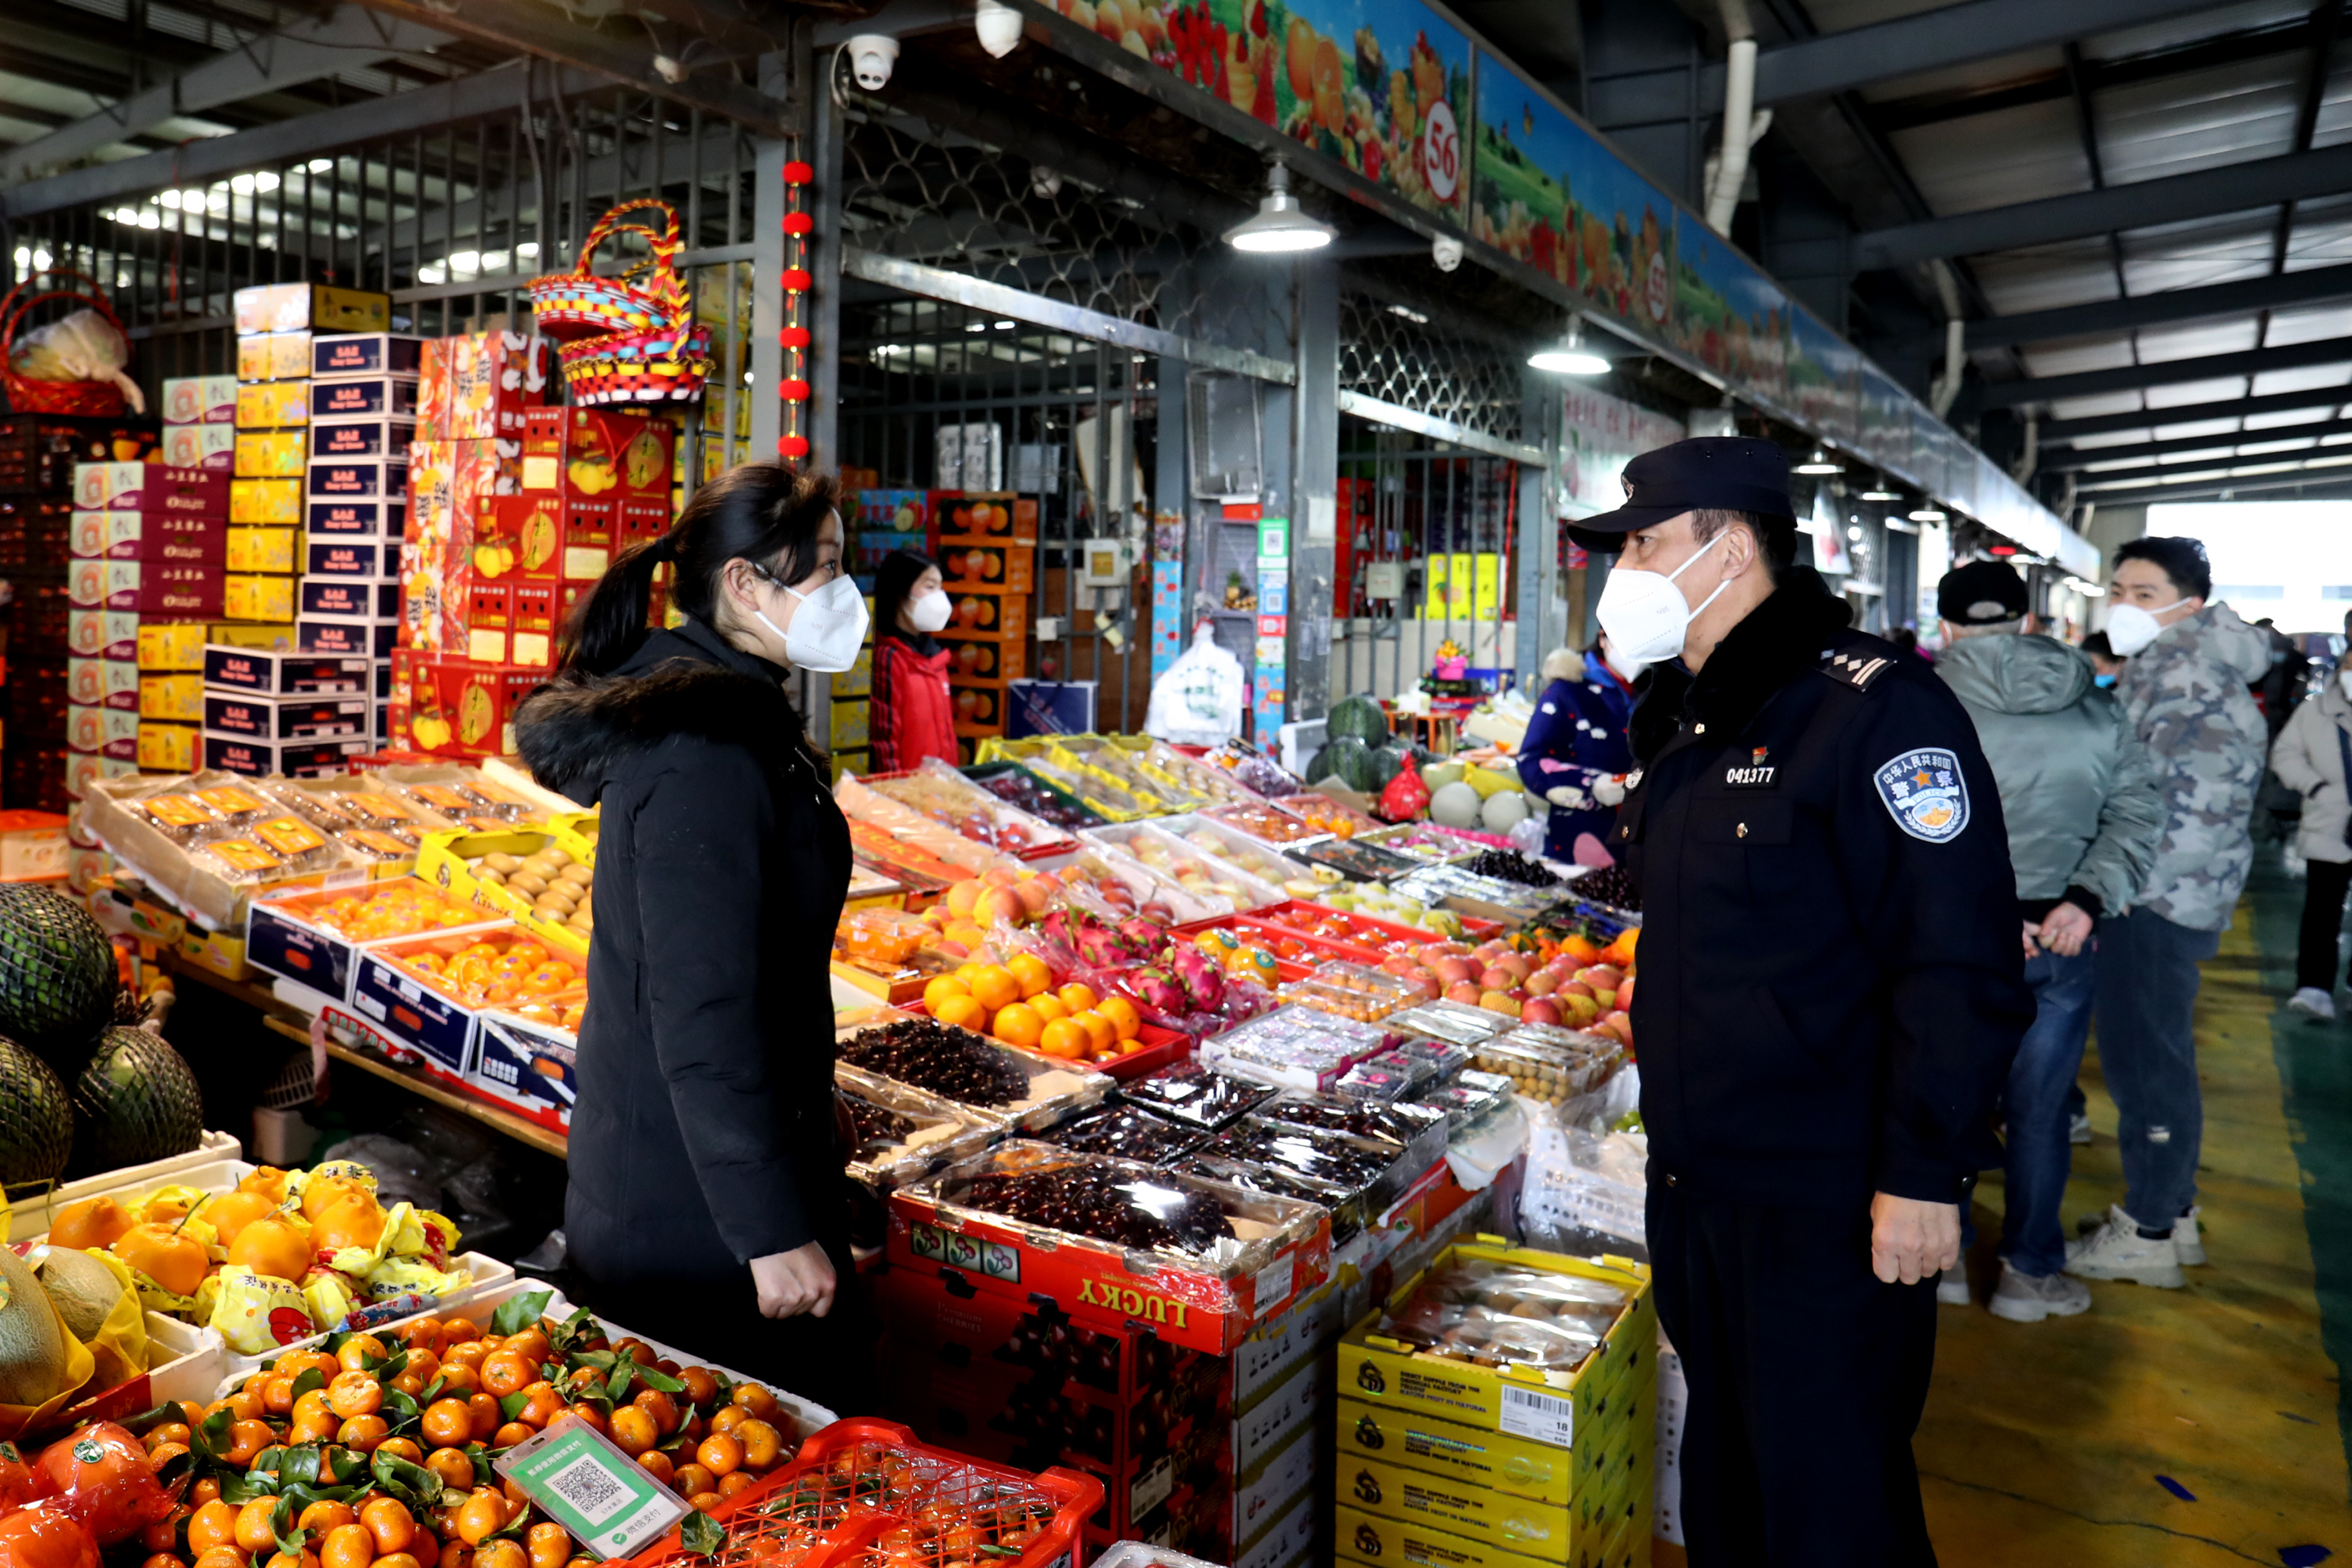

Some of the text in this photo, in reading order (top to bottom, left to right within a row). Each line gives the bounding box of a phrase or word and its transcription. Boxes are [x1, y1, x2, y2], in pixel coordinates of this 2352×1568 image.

[1429, 121, 1456, 180] 56
[1656, 606, 1670, 615] N95
[1727, 767, 1774, 783] 041377
[1882, 754, 1952, 785] 中华人民共和国
[1912, 789, 1944, 803] POLICE
[1077, 1279, 1187, 1328] LUCKY
[937, 1314, 982, 1333] CHERRIES
[1433, 1384, 1462, 1395] FACTORY
[1449, 1381, 1467, 1389] FROM
[1455, 1400, 1487, 1413] NATURAL
[1557, 1422, 1567, 1431] 18
[1438, 1443, 1467, 1453] FACTORY
[527, 1440, 582, 1477] 推荐使用微信支付
[1432, 1453, 1450, 1461] FRUIT
[1460, 1460, 1492, 1472] NATURAL
[601, 1498, 623, 1514] 57水果店
[1436, 1498, 1465, 1509] FACTORY
[1451, 1496, 1470, 1505] FROM
[625, 1508, 661, 1535] 微信支付
[1431, 1509, 1448, 1518] FRUIT
[1459, 1516, 1489, 1528] NATURAL
[1436, 1552, 1465, 1565] FACTORY
[1451, 1549, 1469, 1560] FROM
